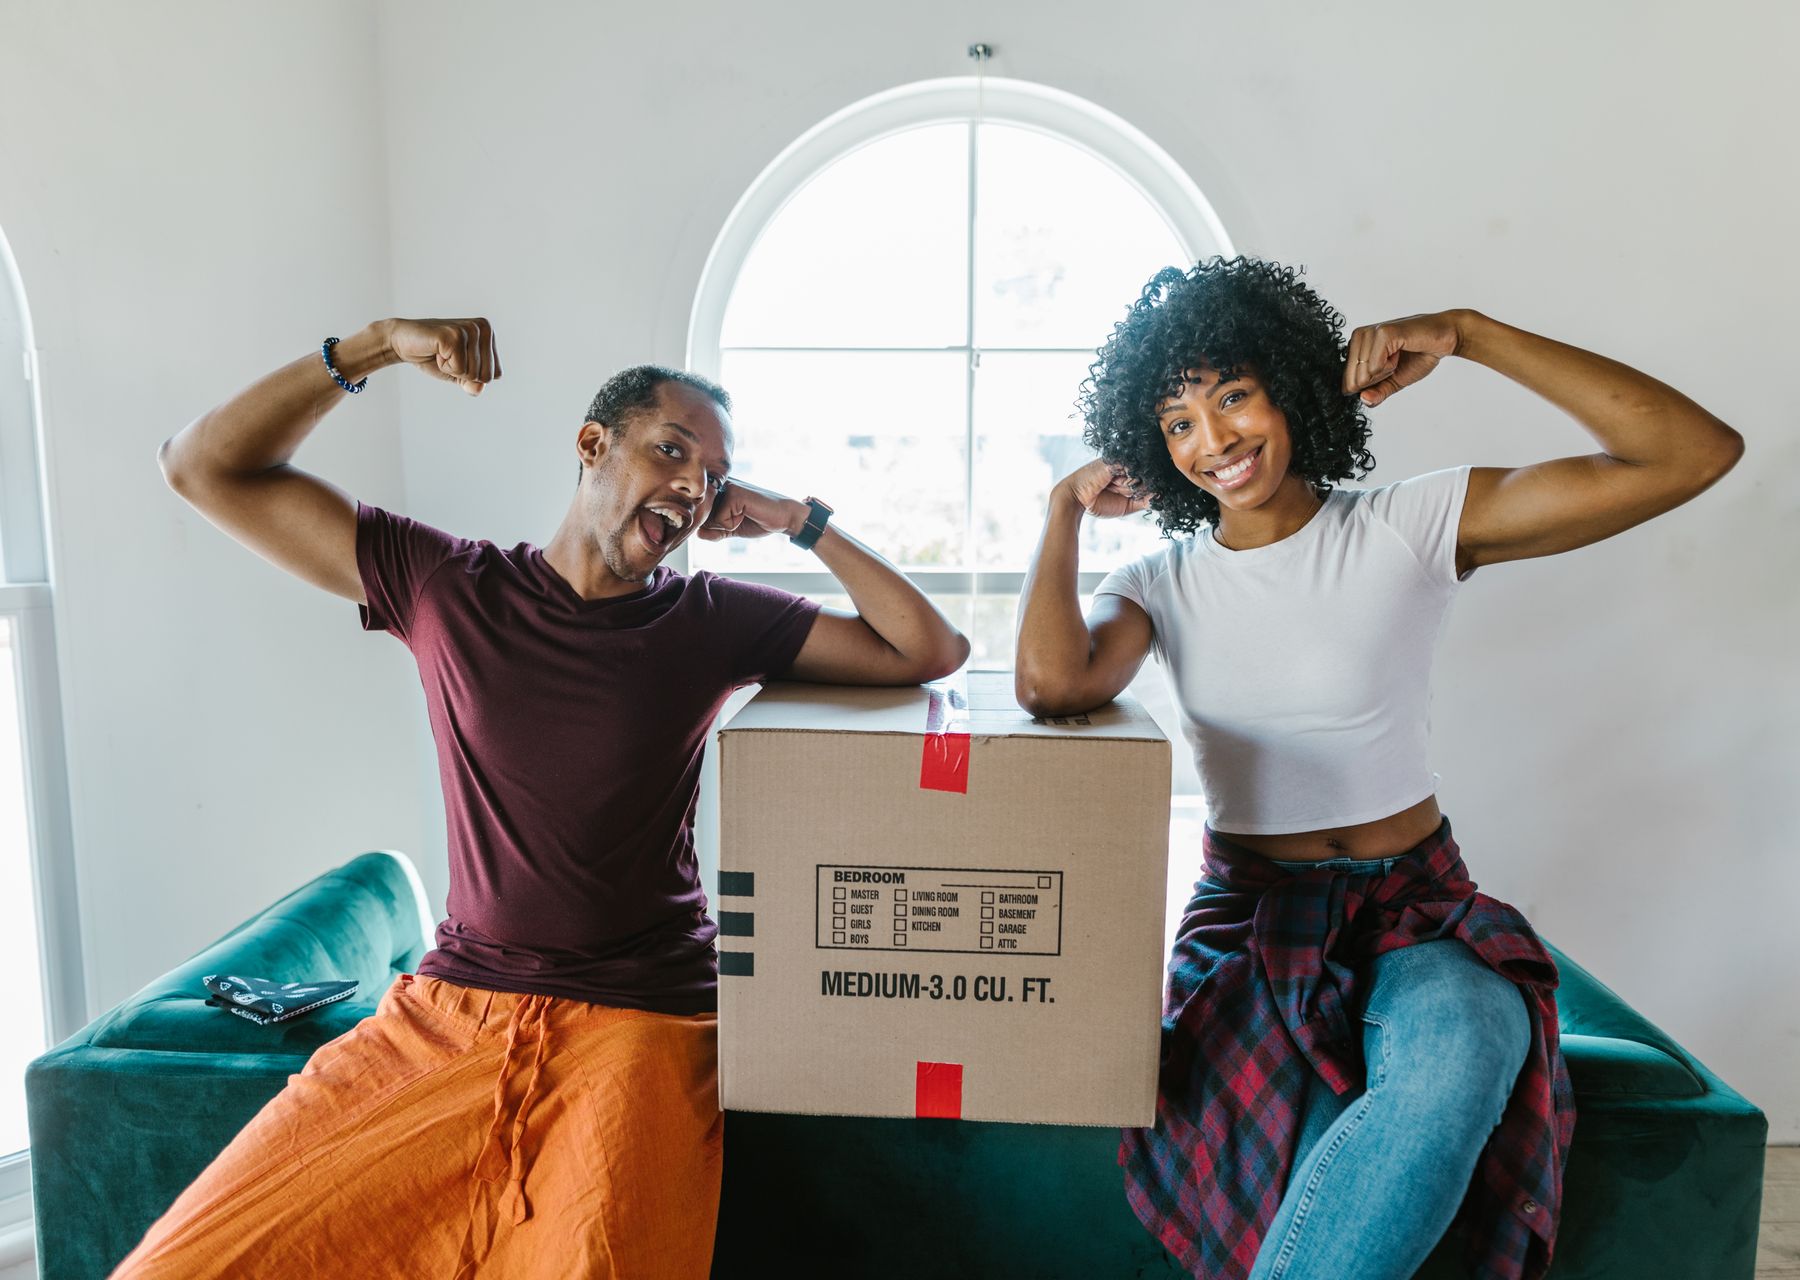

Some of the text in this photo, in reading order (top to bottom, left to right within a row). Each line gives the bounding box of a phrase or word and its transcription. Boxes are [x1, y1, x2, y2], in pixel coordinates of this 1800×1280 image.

[834, 871, 905, 884] BEDROOM
[851, 889, 880, 900] MASTER
[912, 891, 958, 903] LIVING ROOM
[999, 893, 1038, 905] BATHROOM
[851, 904, 874, 915] GUEST
[912, 906, 959, 918] DINING ROOM
[999, 908, 1036, 920] BASEMENT
[851, 919, 871, 930] GIRLS
[912, 921, 941, 932] KITCHEN
[999, 924, 1027, 935] GARAGE
[851, 934, 869, 945] BOYS
[998, 938, 1017, 949] ATTIC
[822, 971, 1055, 1004] MEDIUM-3.0 CU. FT.
